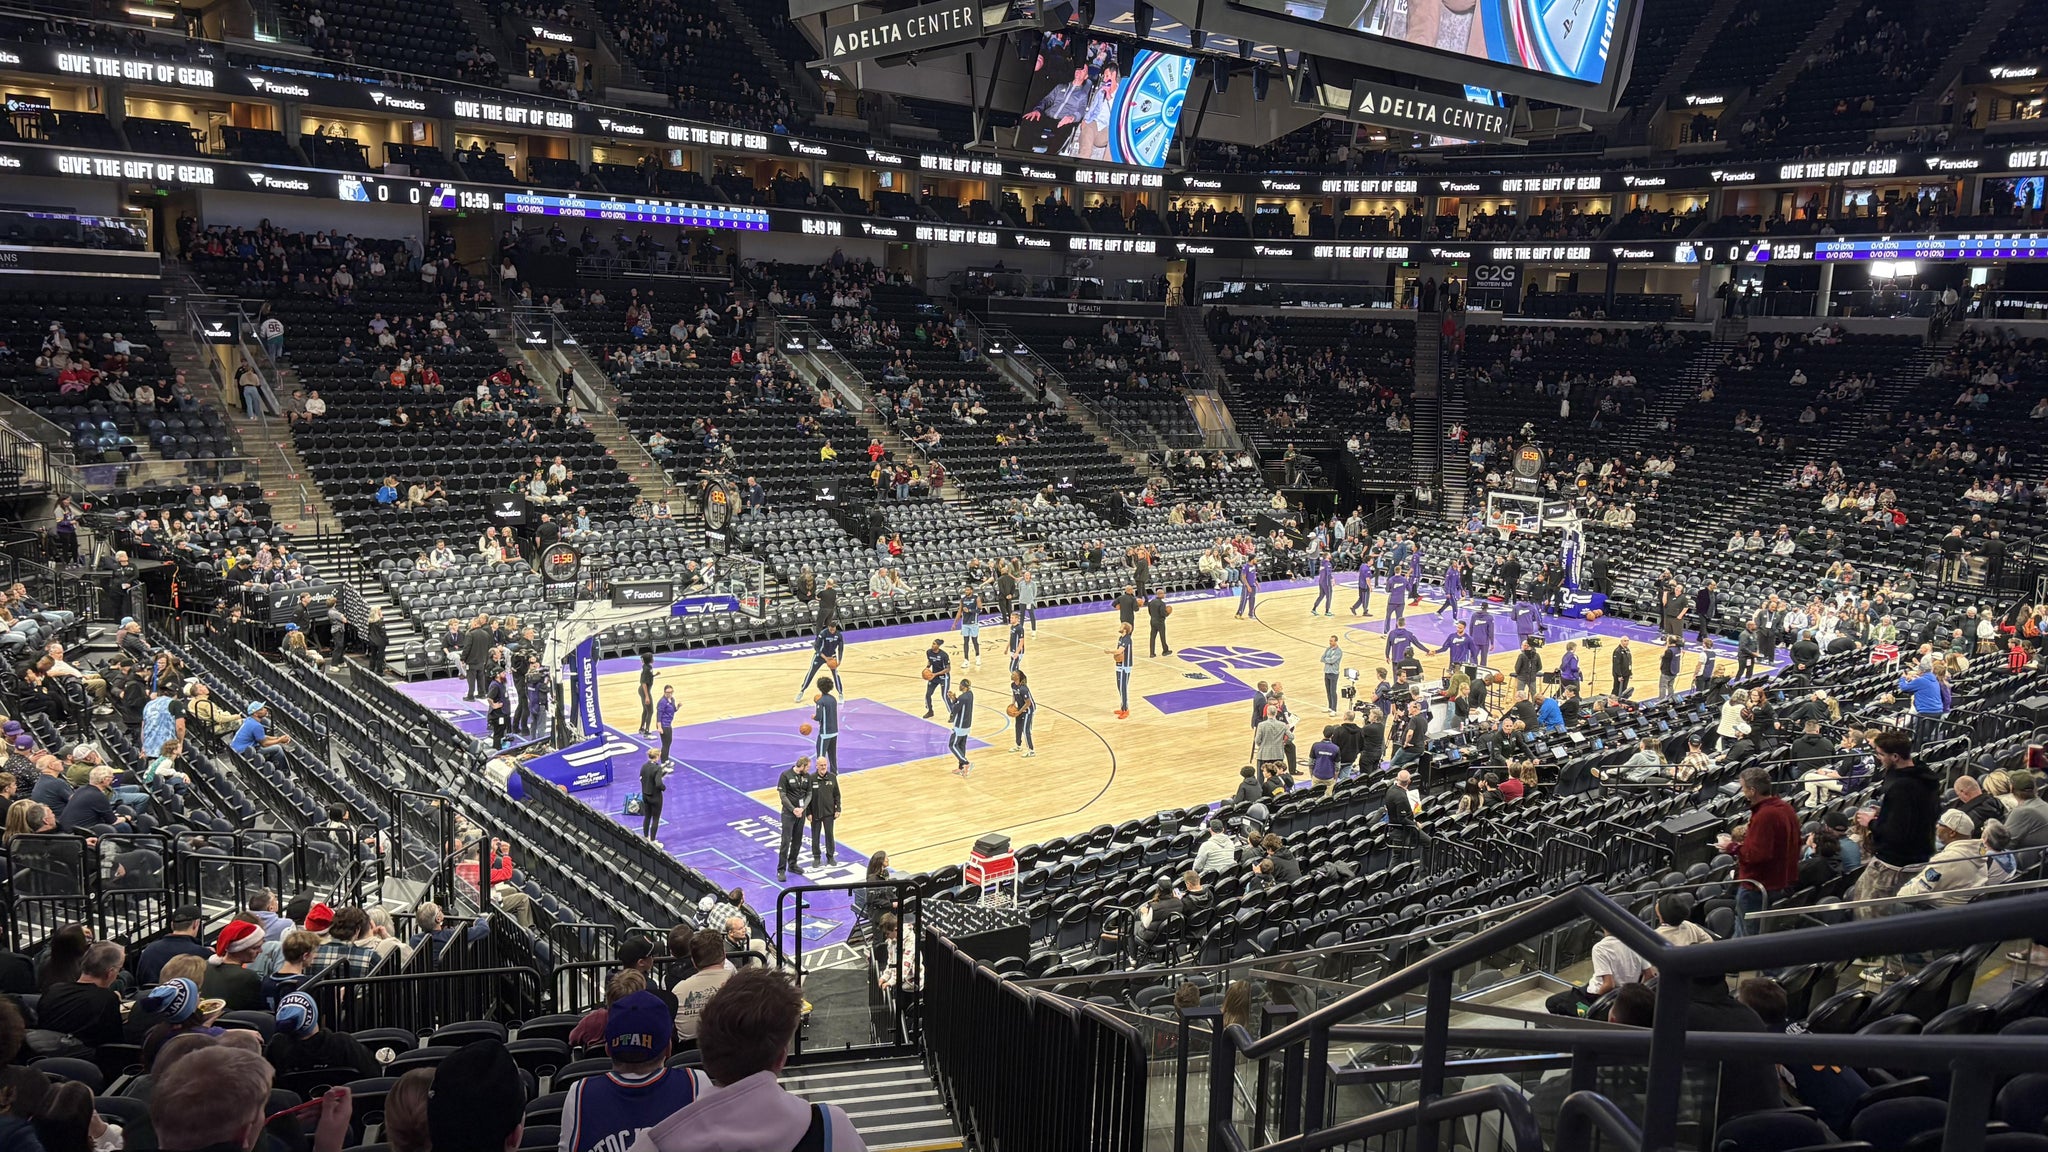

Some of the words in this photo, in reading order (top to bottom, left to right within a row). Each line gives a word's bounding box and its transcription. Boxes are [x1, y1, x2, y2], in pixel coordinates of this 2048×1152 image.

[544, 30, 572, 42] Fanatics
[848, 22, 901, 52] DELTA
[906, 7, 973, 39] CENTER
[58, 54, 90, 73] GIVE
[93, 57, 120, 77] THE
[124, 61, 153, 80] GIFT
[157, 65, 174, 82] OF
[178, 68, 213, 87] GEAR
[2001, 67, 2037, 78] Fanatics
[265, 82, 309, 96] Fanatics
[385, 96, 425, 110] Fanatics
[1695, 96, 1723, 104] Fanatics
[455, 101, 479, 117] GIVE
[482, 104, 502, 120] THE
[505, 107, 527, 123] GIFT
[530, 110, 543, 124] OF
[546, 112, 572, 128] GEAR
[1379, 96, 1437, 123] DELTA
[1443, 106, 1502, 134] CENTER
[611, 122, 644, 134] Fanatics
[668, 126, 688, 141] GIVE
[691, 128, 708, 143] THE
[710, 131, 729, 145] GIFT
[731, 133, 742, 146] OF
[745, 135, 767, 149] GEAR
[800, 144, 827, 155] Fanatics
[875, 152, 901, 163] Fanatics
[1939, 159, 1978, 169] Fanatics
[2009, 151, 2037, 168] GIVE
[59, 156, 91, 174] GIVE
[94, 159, 120, 176] THE
[124, 161, 153, 179] GIFT
[157, 164, 174, 180] OF
[179, 166, 213, 184] GEAR
[921, 156, 937, 168] GIVE
[939, 158, 952, 170] THE
[954, 159, 970, 172] GIFT
[972, 161, 981, 173] OF
[983, 162, 1001, 175] GEAR
[1781, 165, 1804, 179] GIVE
[1806, 163, 1825, 178] THE
[1827, 162, 1850, 176] GIFT
[1852, 161, 1866, 175] OF
[1868, 159, 1897, 174] GEAR
[1029, 169, 1056, 179] Fanatics
[1076, 170, 1093, 183] GIVE
[1095, 172, 1109, 184] THE
[1111, 173, 1128, 185] GIFT
[1130, 174, 1140, 185] OF
[1142, 174, 1162, 186] GEAR
[1721, 171, 1755, 181] Fanatics
[265, 177, 309, 190] Fanatics
[1271, 181, 1300, 190] Fanatics
[1322, 180, 1341, 192] GIVE
[1344, 180, 1359, 192] THE
[1361, 181, 1379, 192] GIFT
[1382, 181, 1393, 192] OF
[1395, 181, 1417, 192] GEAR
[1451, 183, 1479, 191] Fanatics
[1503, 180, 1522, 191] GIVE
[1524, 179, 1540, 191] THE
[1542, 178, 1562, 190] GIFT
[1564, 178, 1575, 190] OF
[1577, 177, 1601, 189] GEAR
[1635, 177, 1665, 186] Fanatics
[378, 185, 388, 201] 0
[410, 188, 420, 204] 0
[460, 191, 489, 209] 13:59
[492, 202, 503, 211] 1ST
[802, 219, 825, 234] 06:49
[827, 221, 840, 235] PM
[872, 226, 897, 236] Fanatics
[916, 227, 932, 240] GIVE
[934, 228, 947, 241] THE
[949, 230, 965, 242] GIFT
[967, 231, 976, 243] OF
[978, 232, 996, 244] GEAR
[1025, 238, 1050, 246] Fanatics
[1070, 238, 1087, 249] GIVE
[1089, 239, 1103, 250] THE
[1104, 240, 1121, 251] GIFT
[1124, 240, 1133, 251] OF
[1135, 241, 1155, 252] GEAR
[1841, 242, 1854, 250] (0%)
[1314, 246, 1333, 257] GIVE
[1335, 247, 1351, 257] THE
[1353, 247, 1371, 258] GIFT
[1373, 247, 1384, 258] OF
[1386, 247, 1408, 258] GEAR
[1493, 248, 1513, 259] GIVE
[1515, 248, 1531, 259] THE
[1533, 248, 1552, 259] GIFT
[1554, 248, 1565, 259] OF
[1567, 247, 1590, 259] GEAR
[1623, 249, 1653, 257] Fanatics
[1704, 247, 1713, 260] 0
[1730, 246, 1738, 260] 0
[1773, 245, 1800, 259] 13:59
[1840, 251, 1853, 259] (0%)
[1870, 250, 1882, 258] 0/0
[1884, 250, 1898, 258] (0%)
[1930, 250, 1944, 258] (0%)
[1475, 265, 1515, 281] G2G
[268, 323, 281, 333] 96
[552, 553, 573, 565] 13:58
[633, 590, 663, 599] Fanatics
[721, 640, 816, 657] EATGEEK
[583, 657, 592, 685] FIRST
[585, 686, 598, 728] AMERICA
[170, 987, 187, 1013] JAZZ
[611, 1034, 653, 1049] UTAH
